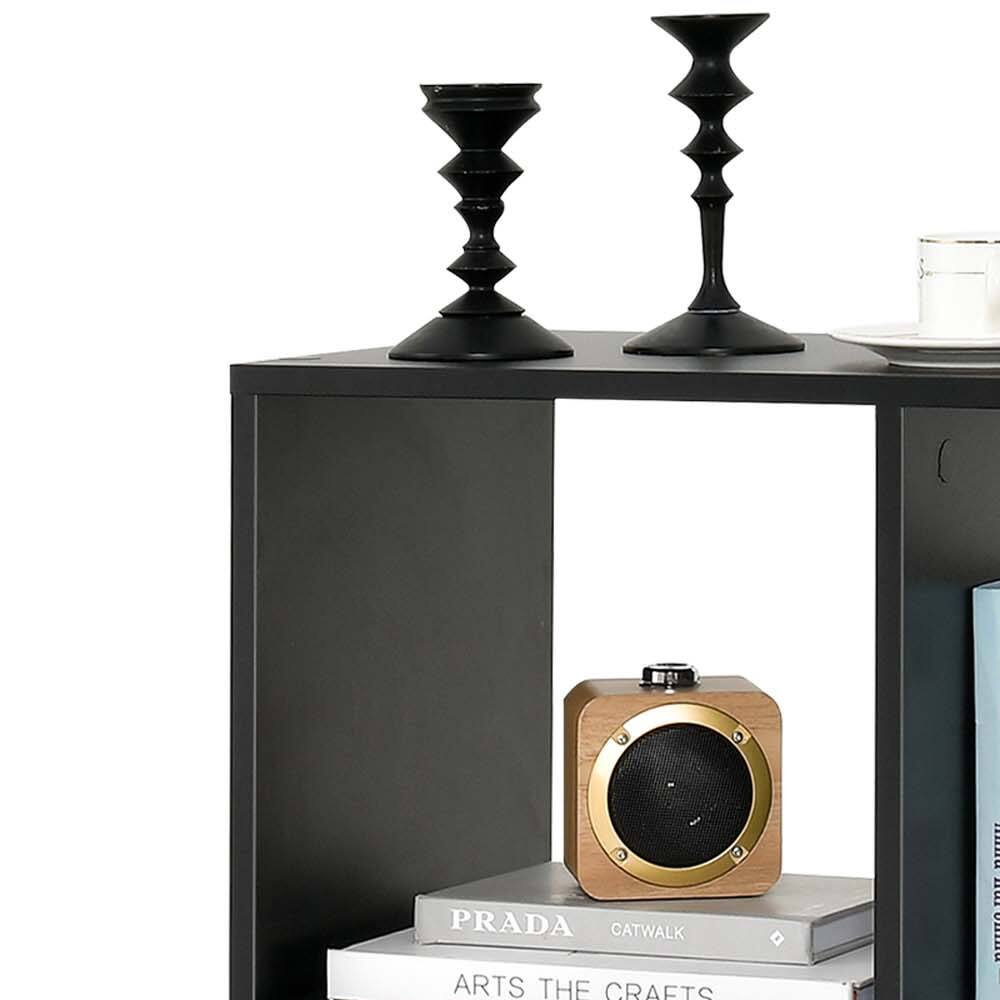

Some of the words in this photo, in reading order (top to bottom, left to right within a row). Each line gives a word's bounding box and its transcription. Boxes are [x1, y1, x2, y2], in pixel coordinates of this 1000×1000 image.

[450, 908, 574, 937] PRADA
[610, 922, 686, 941] CATWALK
[453, 973, 525, 999] ARTS
